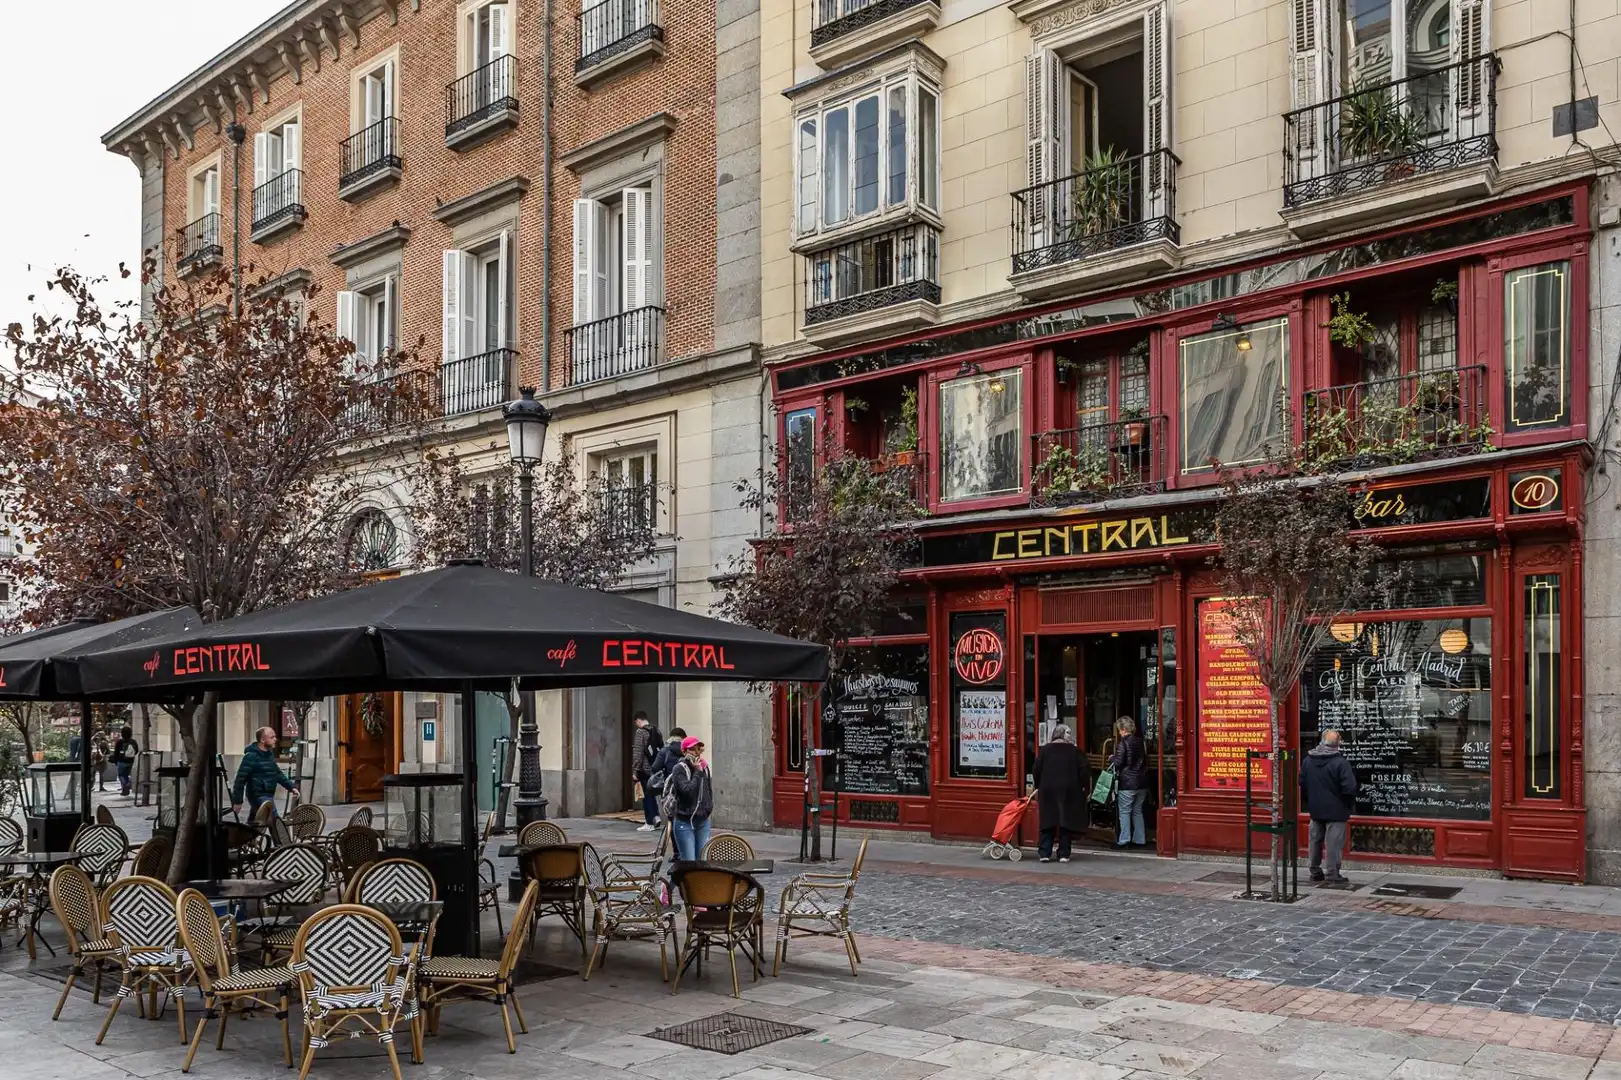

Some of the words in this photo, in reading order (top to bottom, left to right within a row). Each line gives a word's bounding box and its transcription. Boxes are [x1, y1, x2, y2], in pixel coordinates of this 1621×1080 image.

[1523, 481, 1545, 503] 10
[992, 515, 1189, 560] CENTRAL
[547, 639, 577, 668] café
[602, 640, 735, 669] CENTRAL
[960, 632, 999, 654] MÚSICA
[174, 643, 270, 675] CENTRAL
[960, 660, 999, 680] VIVO
[1358, 652, 1406, 678] Central
[1411, 651, 1466, 682] Madrid
[1378, 677, 1409, 685] MEN
